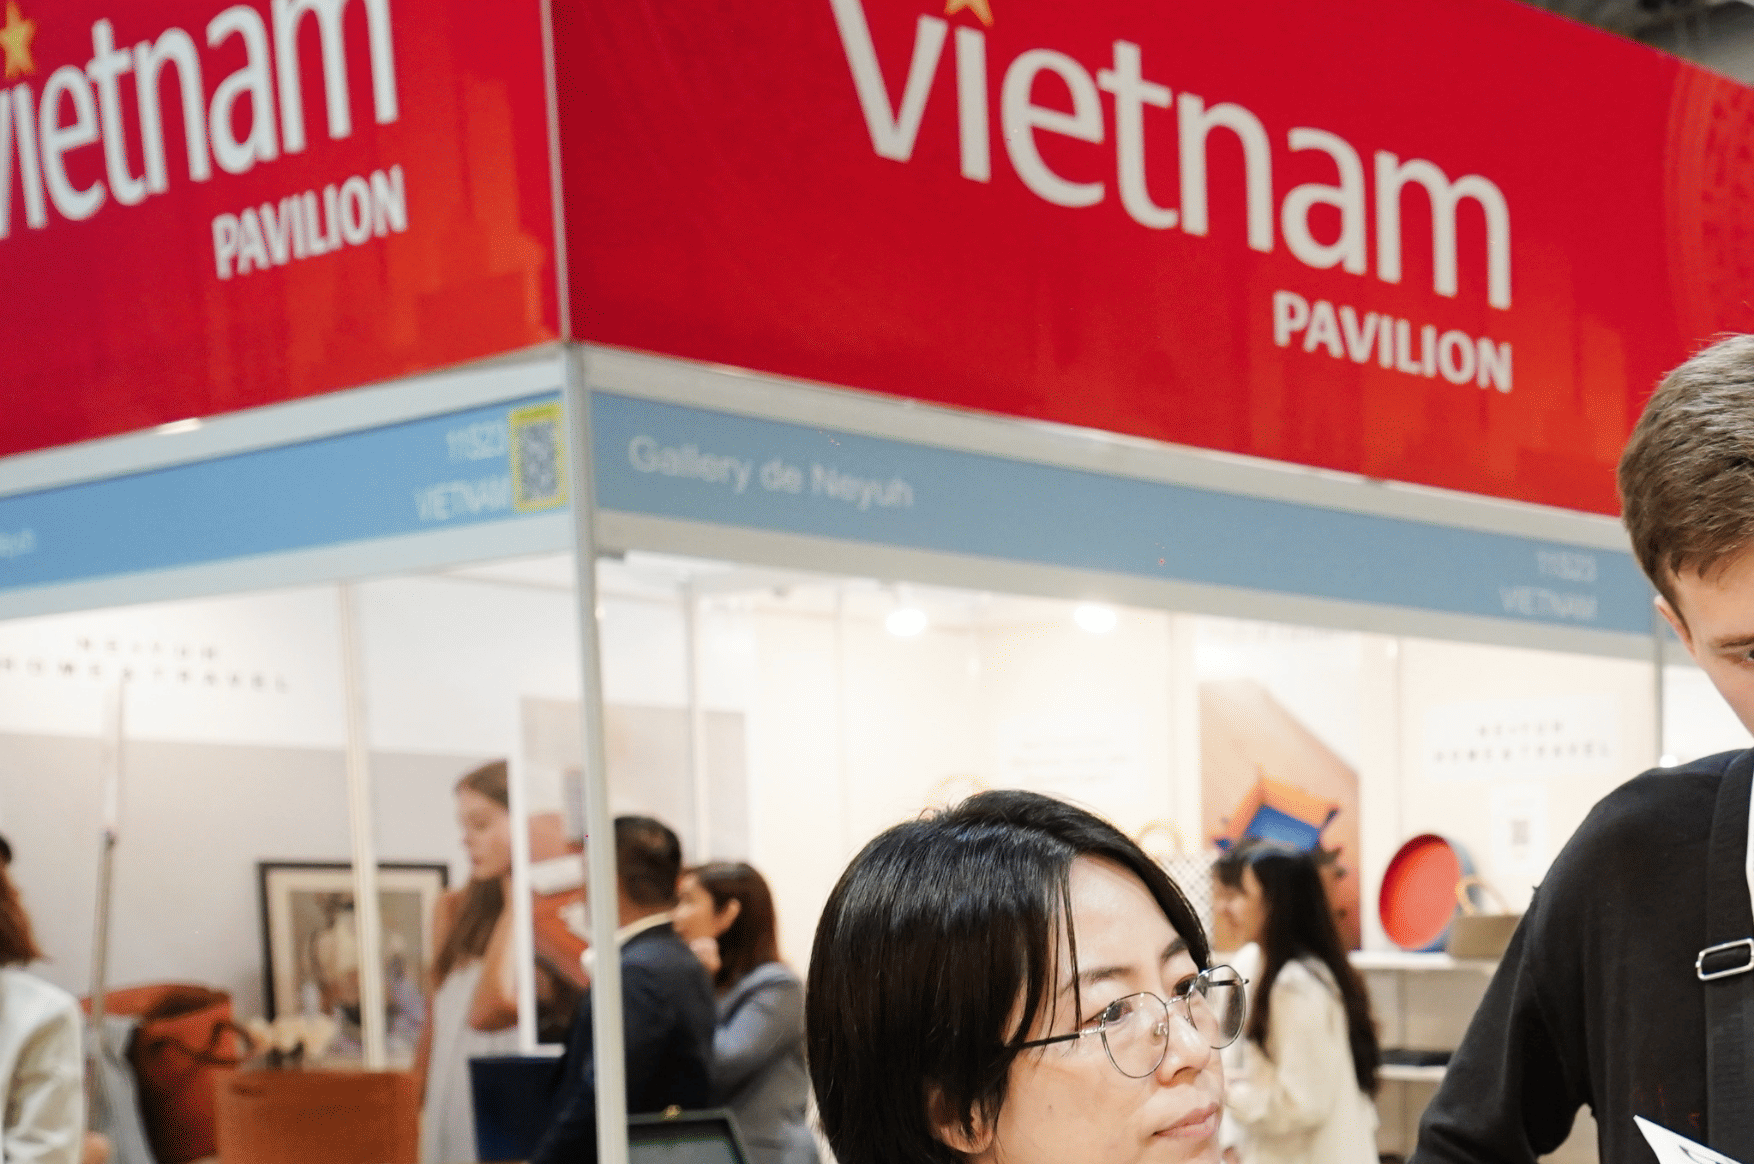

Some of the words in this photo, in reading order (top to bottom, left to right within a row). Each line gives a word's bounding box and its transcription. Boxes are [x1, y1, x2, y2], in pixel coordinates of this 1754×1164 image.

[0, 0, 398, 240] ietnam
[828, 0, 1512, 309] Vietnam
[212, 166, 408, 280] PAVILION
[1272, 291, 1514, 393] PAVILION
[627, 434, 753, 494] Gallery
[759, 456, 803, 493] de
